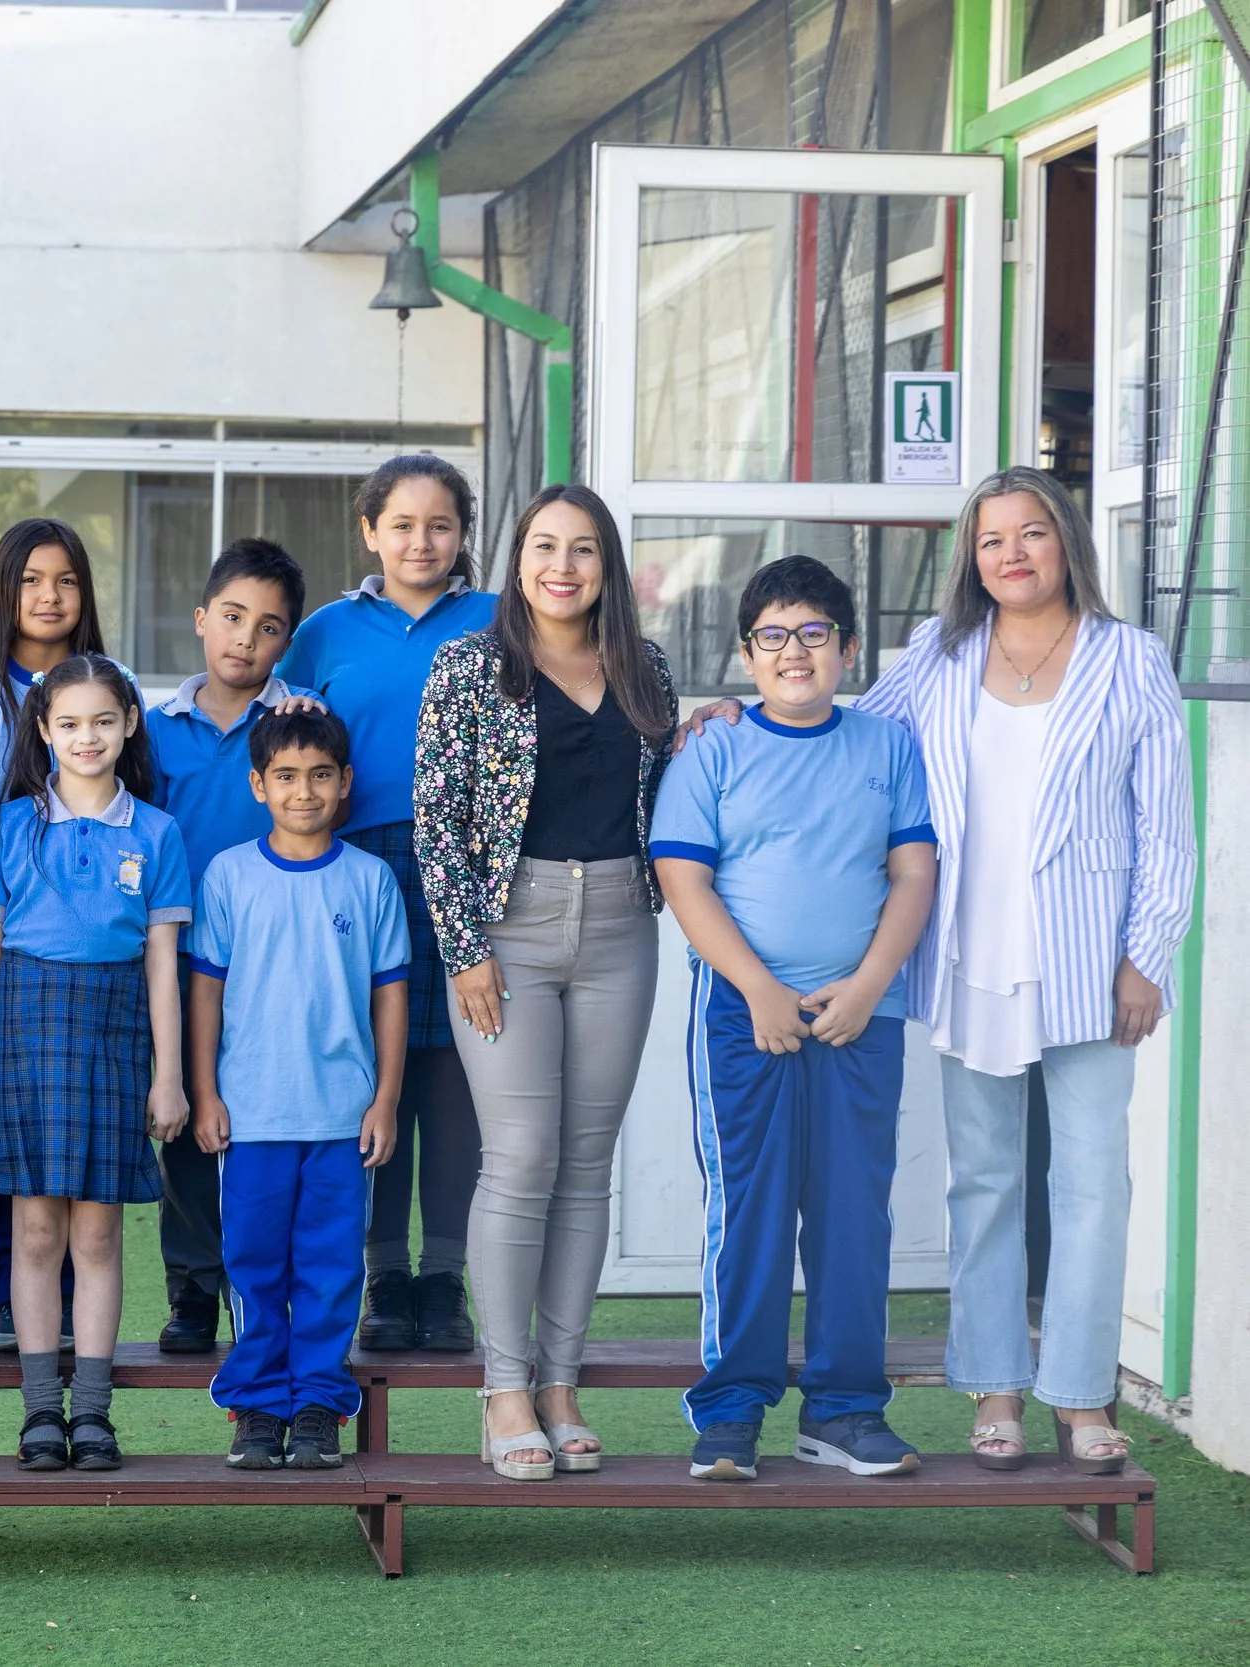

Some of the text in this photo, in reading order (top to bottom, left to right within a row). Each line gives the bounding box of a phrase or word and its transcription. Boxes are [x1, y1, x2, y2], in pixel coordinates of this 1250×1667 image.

[903, 445, 942, 453] SALIDA DE
[333, 913, 352, 936] EM
